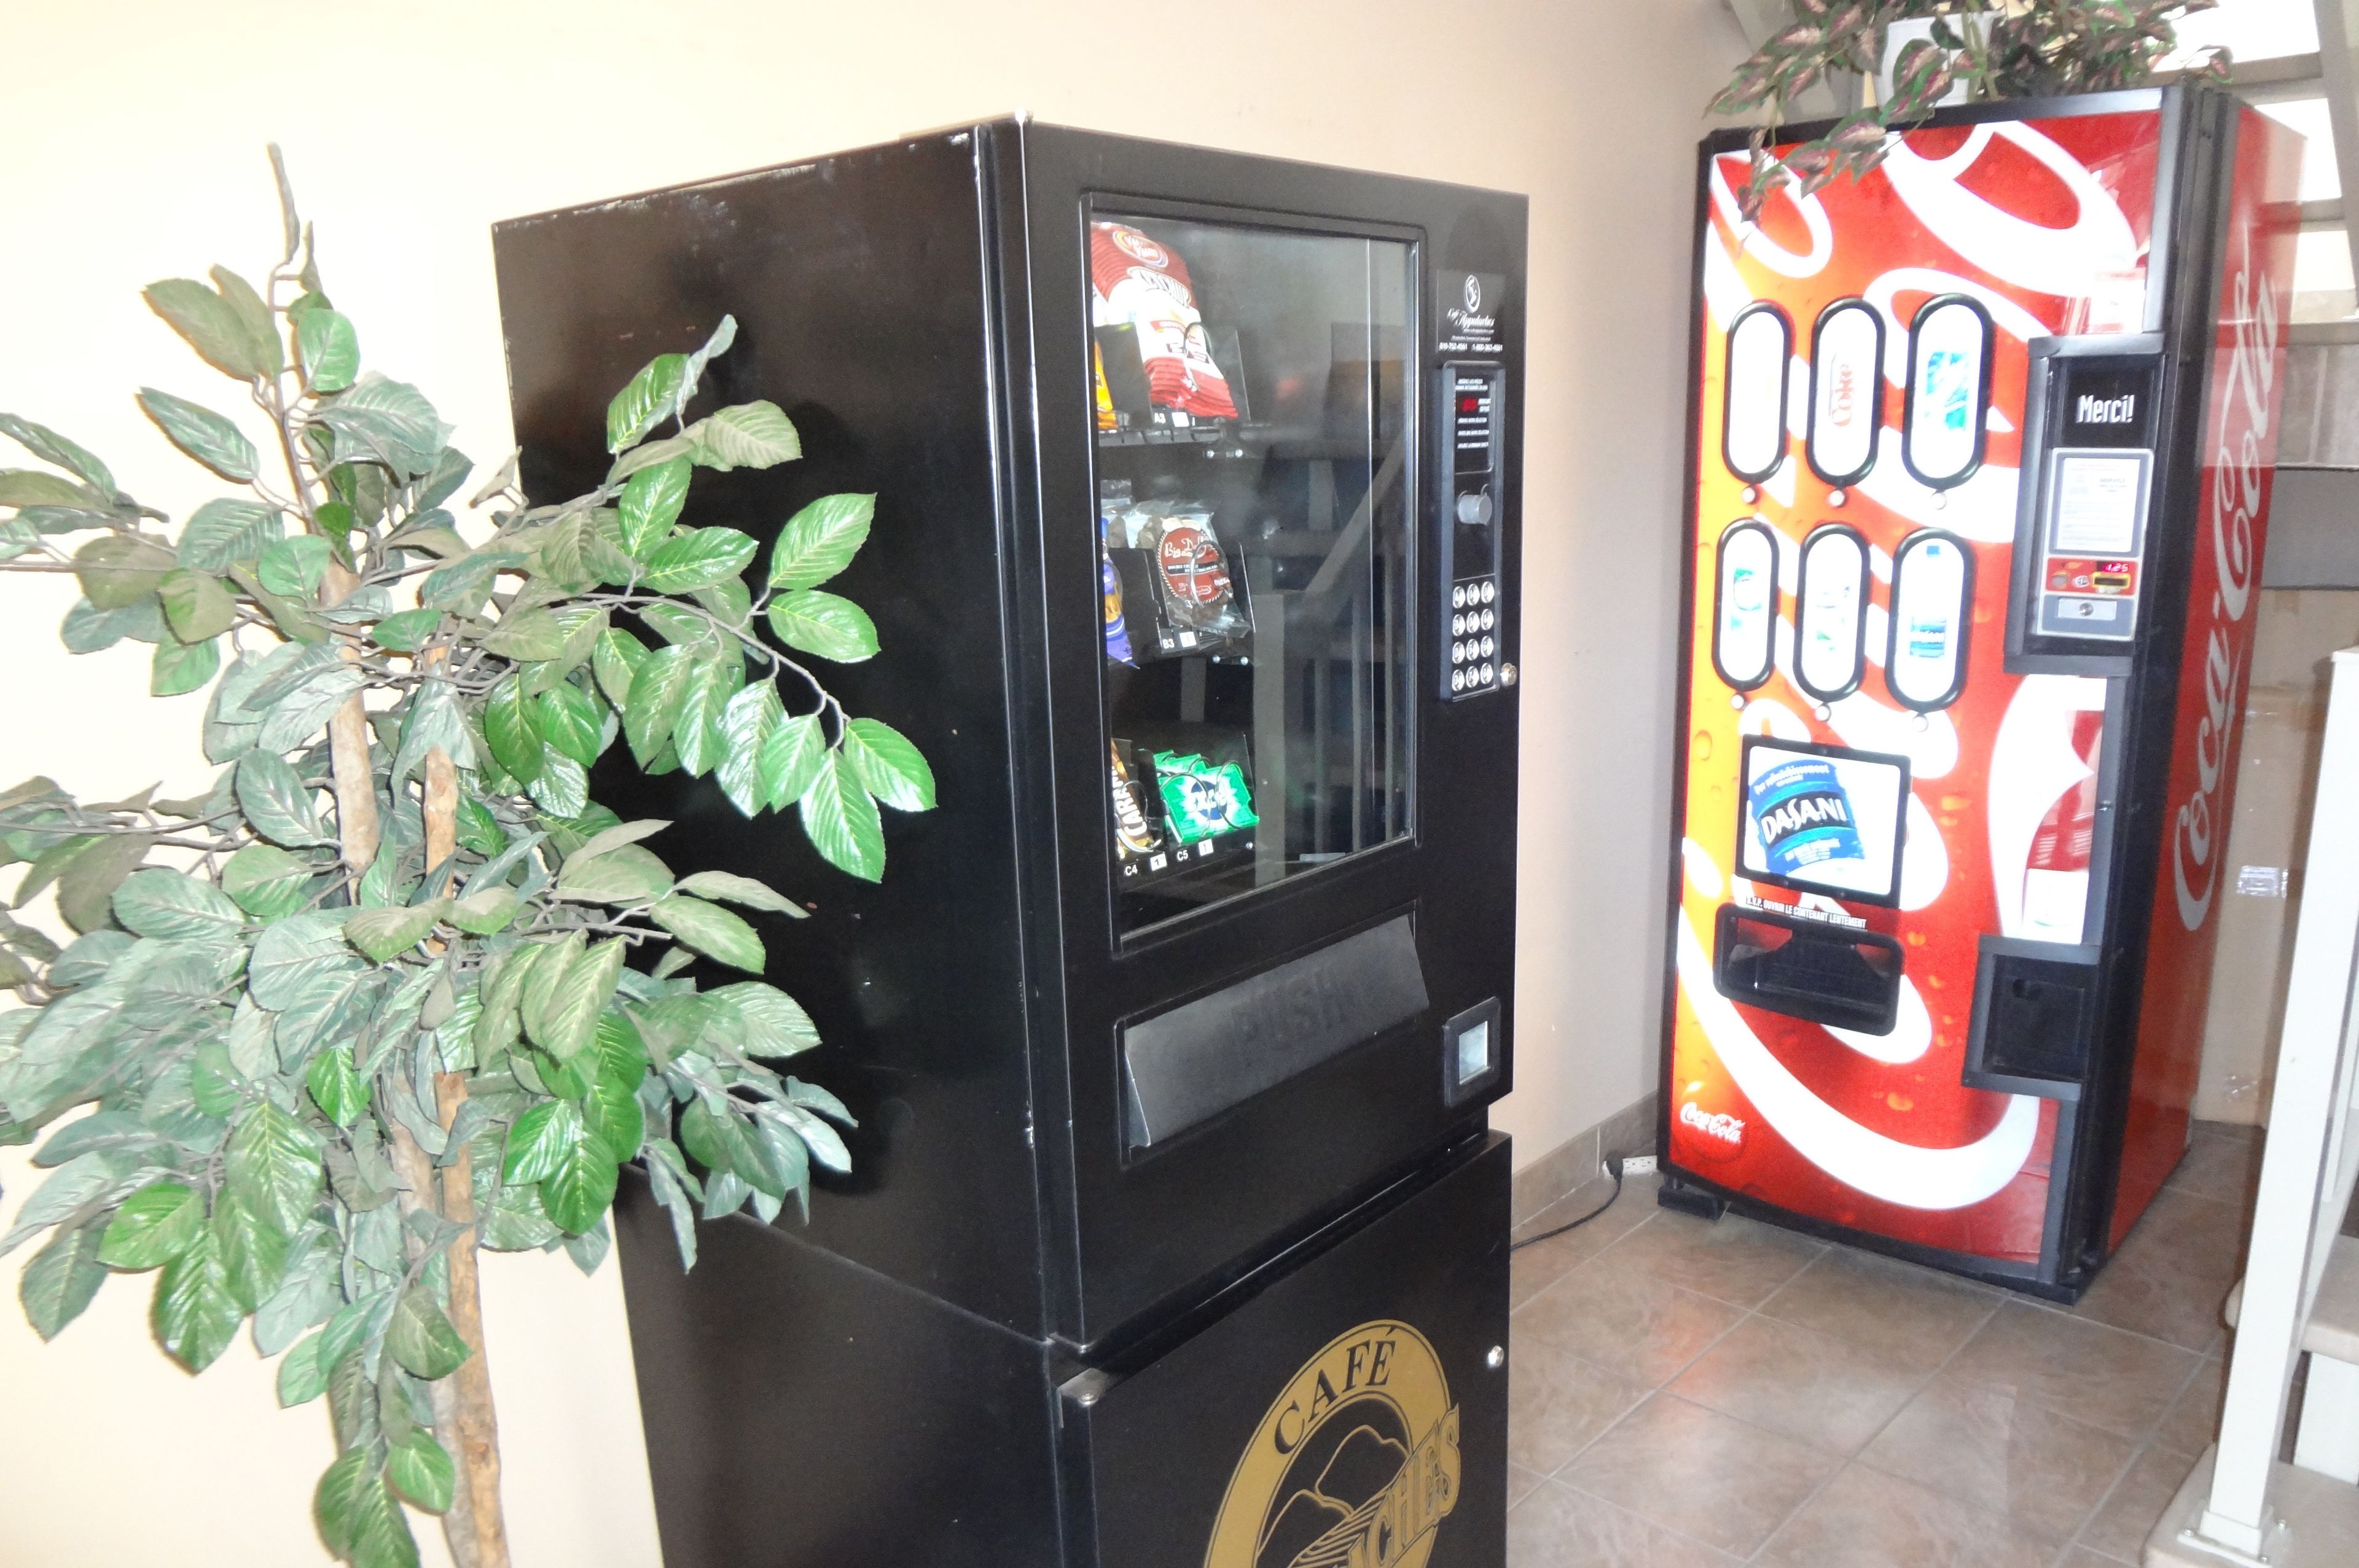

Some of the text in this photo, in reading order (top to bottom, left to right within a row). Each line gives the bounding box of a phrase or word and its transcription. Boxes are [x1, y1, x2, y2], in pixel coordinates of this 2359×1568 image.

[2076, 394, 2135, 423] Merci!
[1162, 639, 1175, 649] B3
[1761, 797, 1847, 846] DASANI
[1176, 850, 1189, 861] C5
[1125, 865, 1138, 876] C4
[1785, 904, 1793, 914] LE
[1793, 906, 1829, 922] CONTENANT
[1829, 913, 1867, 928] LENTEMENT
[1680, 1101, 1746, 1143] Coca-Cola
[1274, 1327, 1396, 1455] CAFÉ
